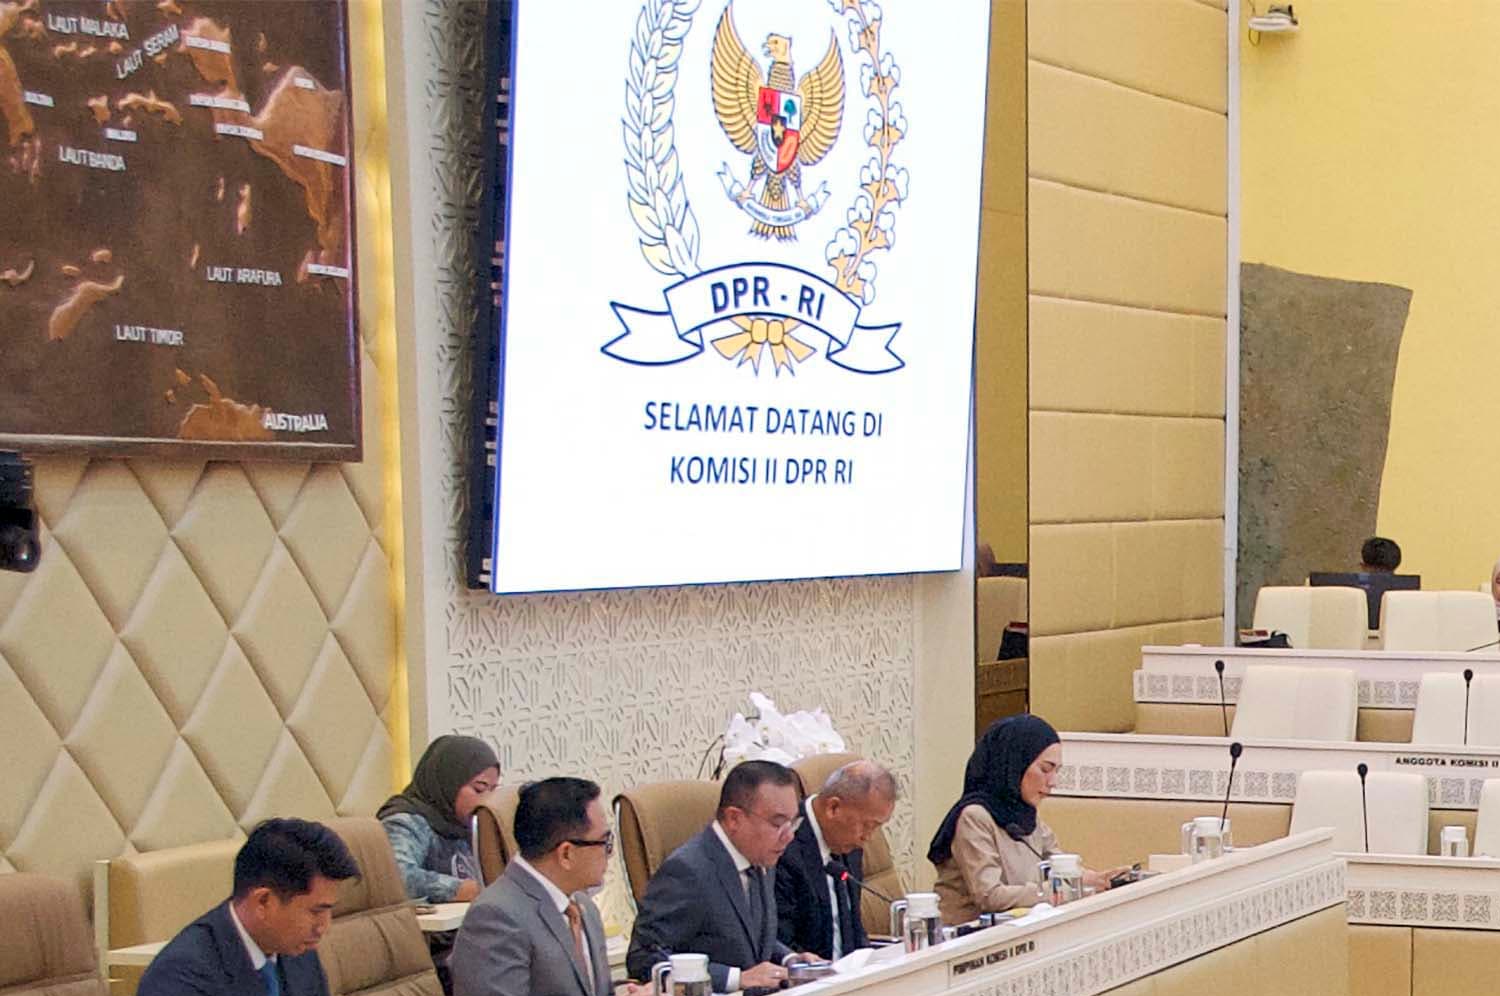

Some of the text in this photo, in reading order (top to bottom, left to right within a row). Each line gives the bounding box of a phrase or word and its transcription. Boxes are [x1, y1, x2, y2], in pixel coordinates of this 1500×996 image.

[48, 13, 78, 34] LAUT
[116, 48, 143, 79] LAUT
[59, 145, 88, 165] LAUT
[206, 265, 283, 286] LAUT ARAFURA
[711, 276, 770, 313] DPR
[798, 284, 825, 320] RI
[116, 324, 184, 345] LAUT TIMOR
[263, 412, 328, 433] AUSTRALIA
[643, 401, 882, 437] SELAMAT DATANG DI
[670, 456, 853, 484] KOMISI II DPR RI
[1395, 757, 1446, 767] ANGGOTA
[1450, 758, 1489, 768] KOMISI
